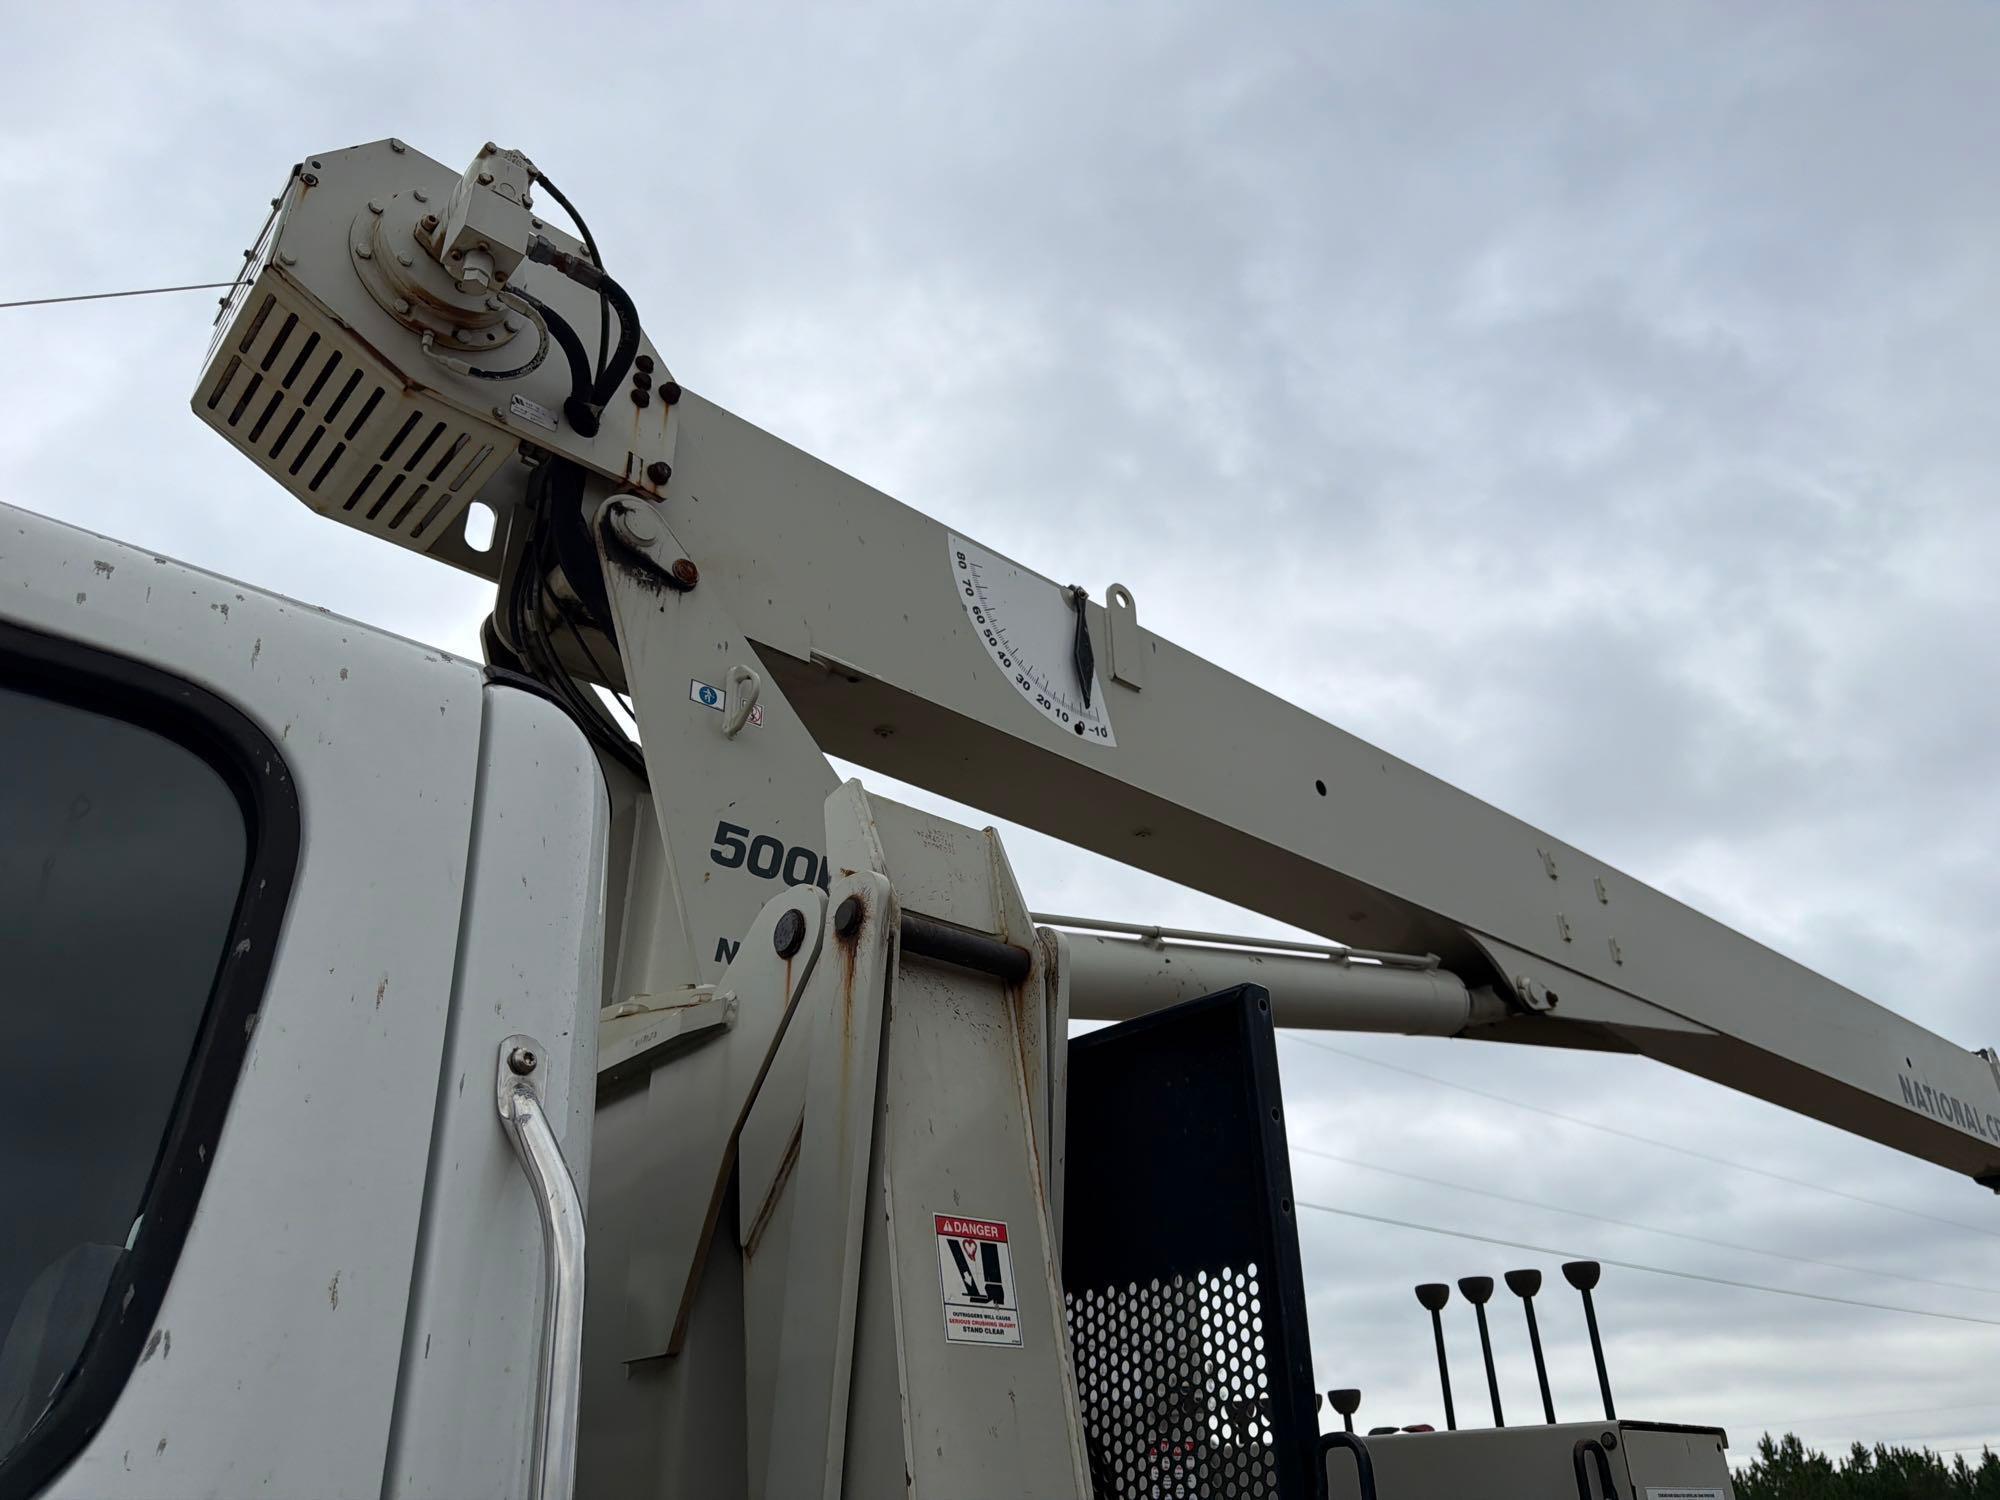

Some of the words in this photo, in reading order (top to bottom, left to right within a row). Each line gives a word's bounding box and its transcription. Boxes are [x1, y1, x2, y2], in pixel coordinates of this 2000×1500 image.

[956, 551, 967, 570] 80
[962, 579, 974, 597] 70
[972, 606, 985, 624] 60
[983, 628, 997, 647] 50
[997, 651, 1011, 668] 40
[1015, 674, 1031, 691] 30
[1036, 694, 1051, 710] 20
[1055, 708, 1069, 723] 10
[1898, 1073, 1987, 1137] NATIONAL
[954, 1221, 998, 1237] DANGER
[963, 1326, 983, 1334] STAND
[972, 1320, 998, 1328] CRUSHING
